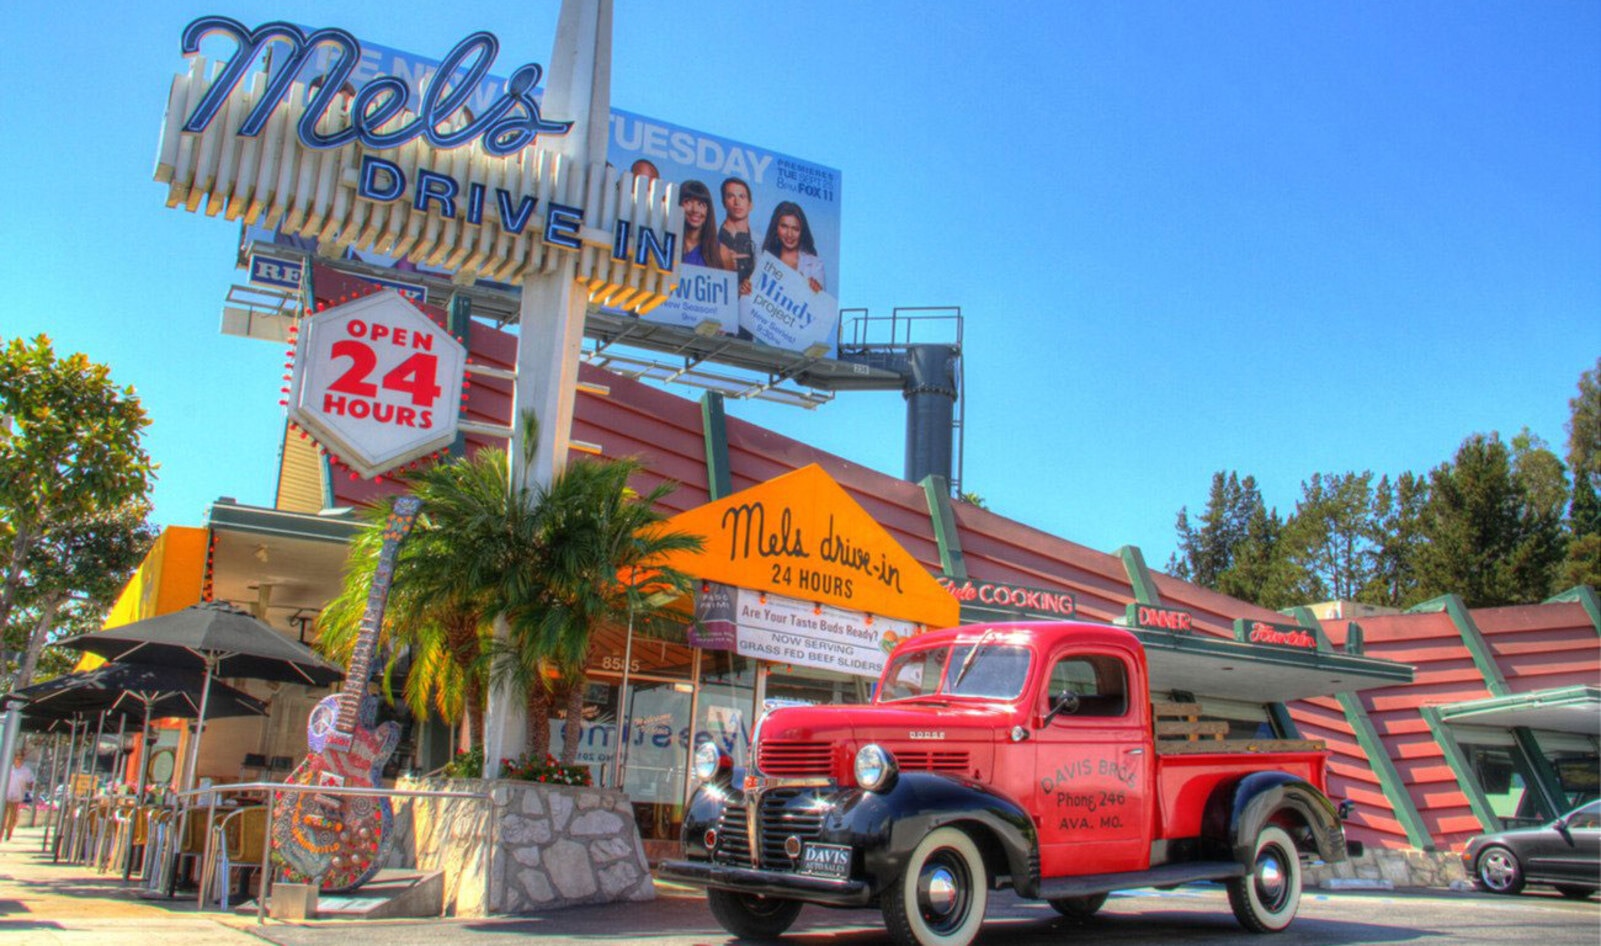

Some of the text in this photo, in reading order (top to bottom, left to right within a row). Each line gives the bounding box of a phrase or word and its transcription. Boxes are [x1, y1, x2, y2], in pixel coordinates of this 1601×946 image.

[182, 15, 573, 156] Mels
[778, 167, 797, 181] TUE
[798, 182, 821, 200] FOX
[823, 189, 834, 202] 11
[358, 155, 676, 274] DRIVE IN
[763, 261, 784, 281] the
[694, 275, 729, 306] Girl
[758, 271, 816, 330] Mindy
[753, 294, 796, 328] project
[346, 319, 434, 352] OPEN
[326, 339, 442, 408] 24
[323, 394, 433, 430] HOURS
[722, 502, 903, 594] Mels drive-in
[771, 563, 854, 599] 24 HOURS
[979, 584, 1073, 615] COOKING
[742, 605, 761, 619] Are
[764, 608, 787, 624] Your
[790, 613, 817, 630] Taste
[820, 621, 844, 636] Buds
[846, 625, 879, 643] Ready?
[1138, 606, 1192, 632] DINNER
[1249, 622, 1317, 649] Fountain
[739, 640, 882, 673] GRASS FED BEEF SLIDERS
[772, 633, 854, 656] NOW SERVING
[909, 731, 945, 740] DODGE
[1041, 758, 1137, 795] DAVIS BROS
[1099, 790, 1126, 807] 246
[805, 847, 849, 865] DAVIS
